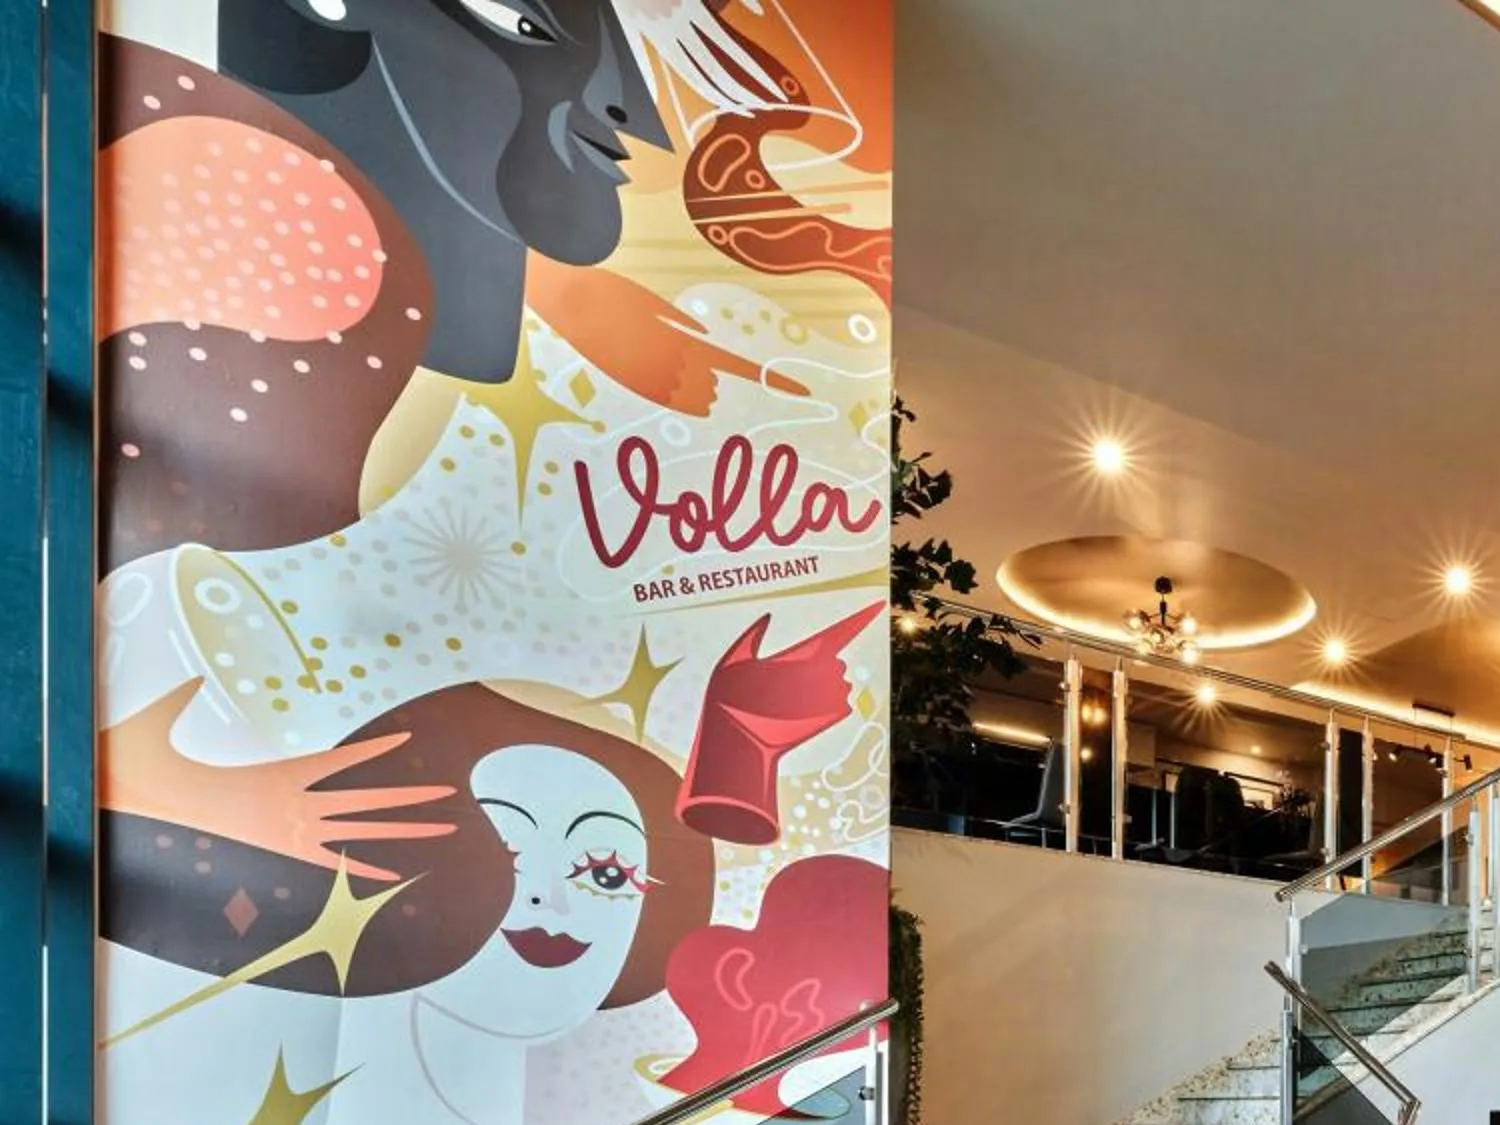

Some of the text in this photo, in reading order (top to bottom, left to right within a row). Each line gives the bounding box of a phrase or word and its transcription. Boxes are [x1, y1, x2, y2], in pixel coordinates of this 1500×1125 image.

[574, 434, 882, 568] Volla
[633, 555, 819, 603] BAR & RESTAURANT
